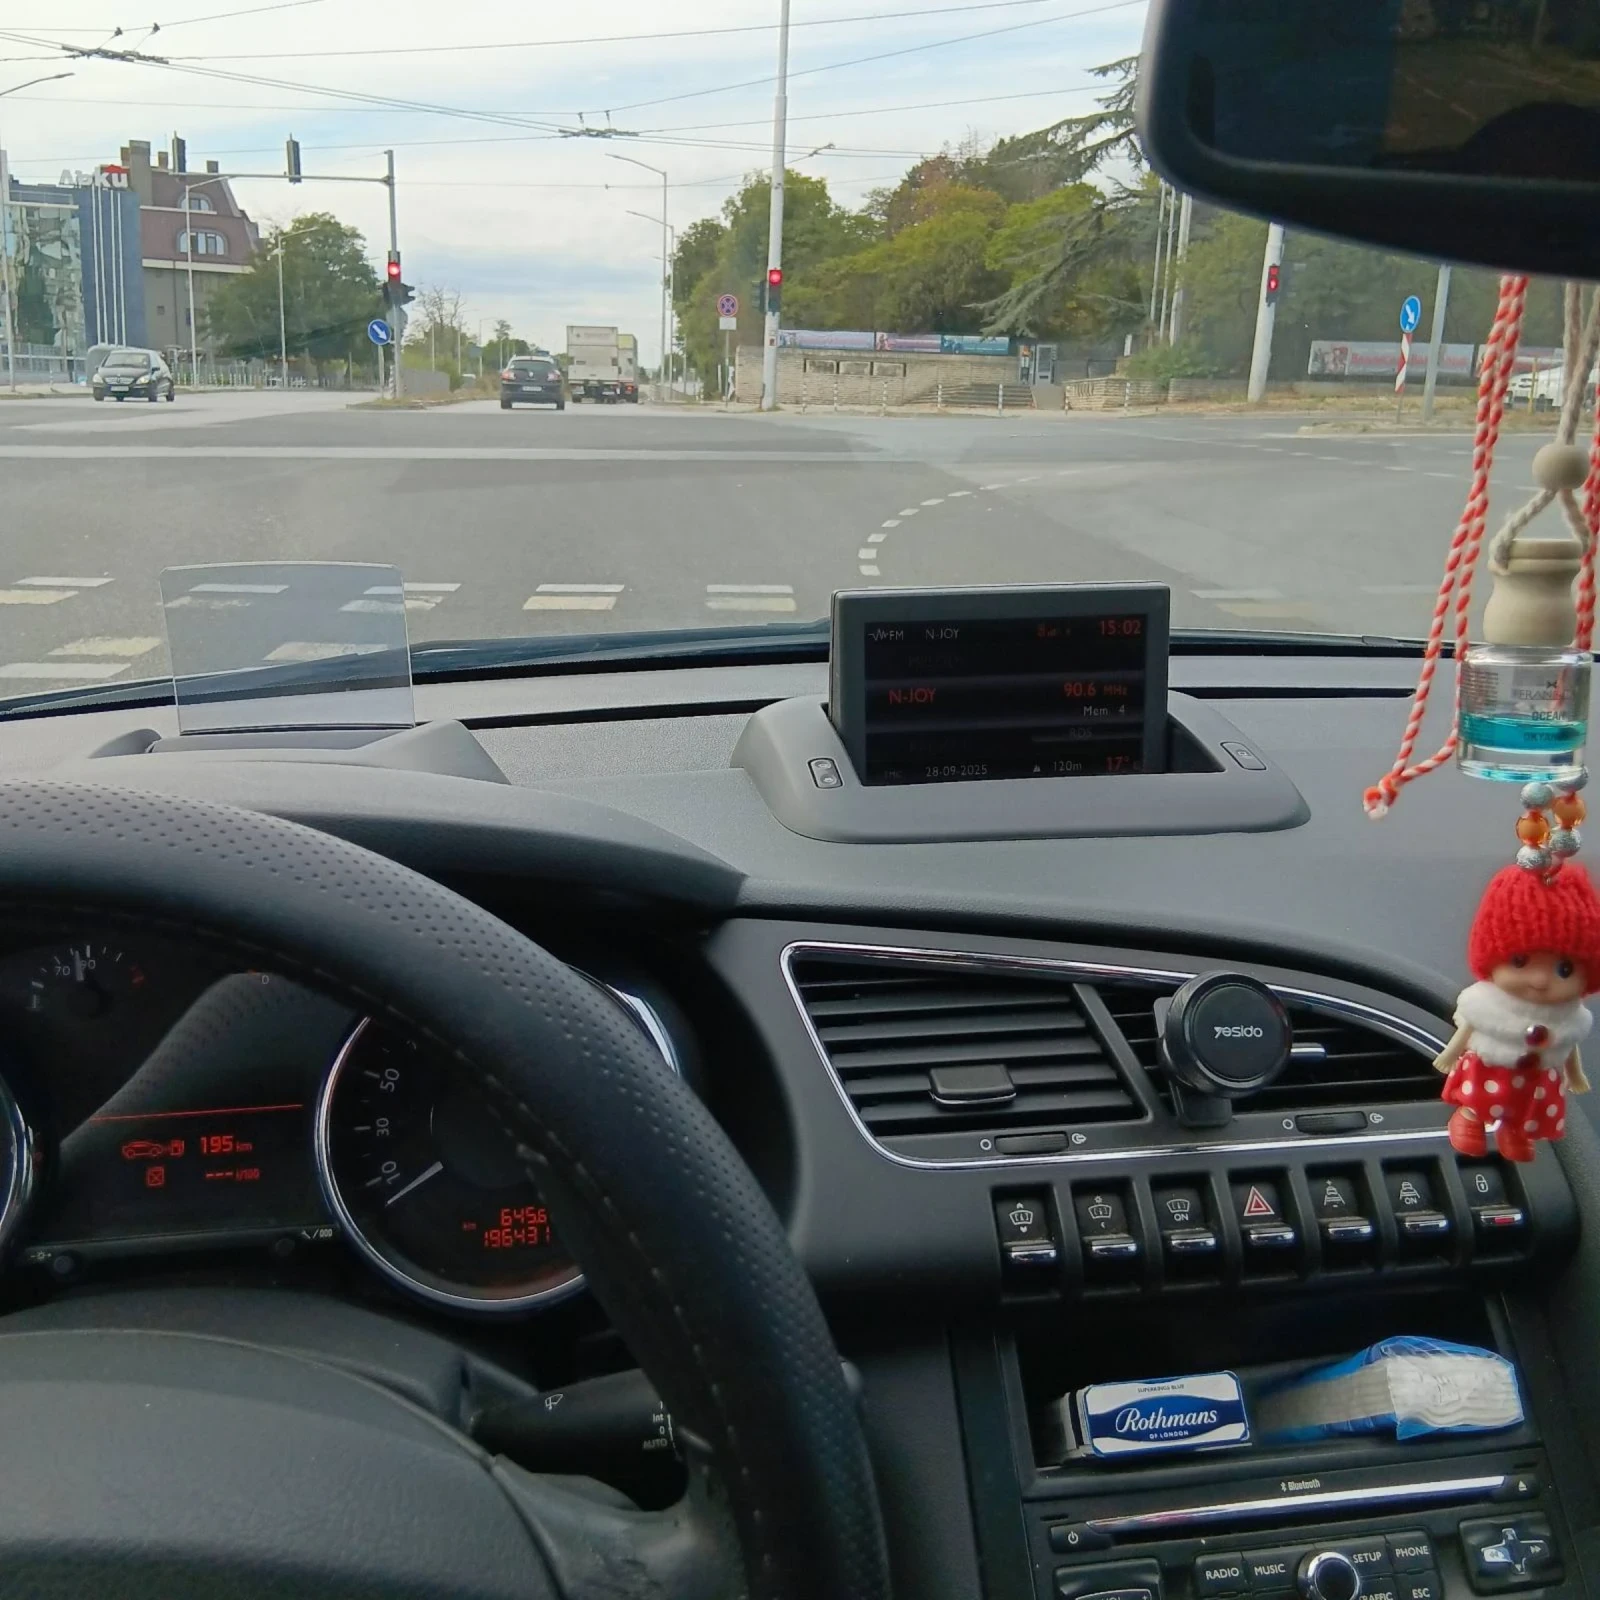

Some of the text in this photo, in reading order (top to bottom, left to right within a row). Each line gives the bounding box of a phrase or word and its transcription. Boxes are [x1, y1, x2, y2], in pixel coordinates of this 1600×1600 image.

[1100, 619, 1142, 635] 15:02
[888, 687, 937, 705] N-JOY
[1063, 681, 1097, 698] 90.6
[1083, 704, 1126, 717] Mem 4
[380, 1068, 400, 1092] 50
[376, 1117, 389, 1137] 30
[200, 1135, 234, 1154] 195
[1404, 1197, 1418, 1205] ON
[1173, 1213, 1189, 1222] ON
[1115, 1406, 1218, 1433] Rothmans
[1159, 1430, 1189, 1439] LONDON
[1287, 1478, 1321, 1491] Bluetooth
[1352, 1551, 1383, 1564] SETUP
[1395, 1545, 1430, 1559] PHONE
[1205, 1567, 1240, 1581] RADIO
[1254, 1562, 1287, 1577] MUSIC
[1411, 1587, 1431, 1599] ESC
